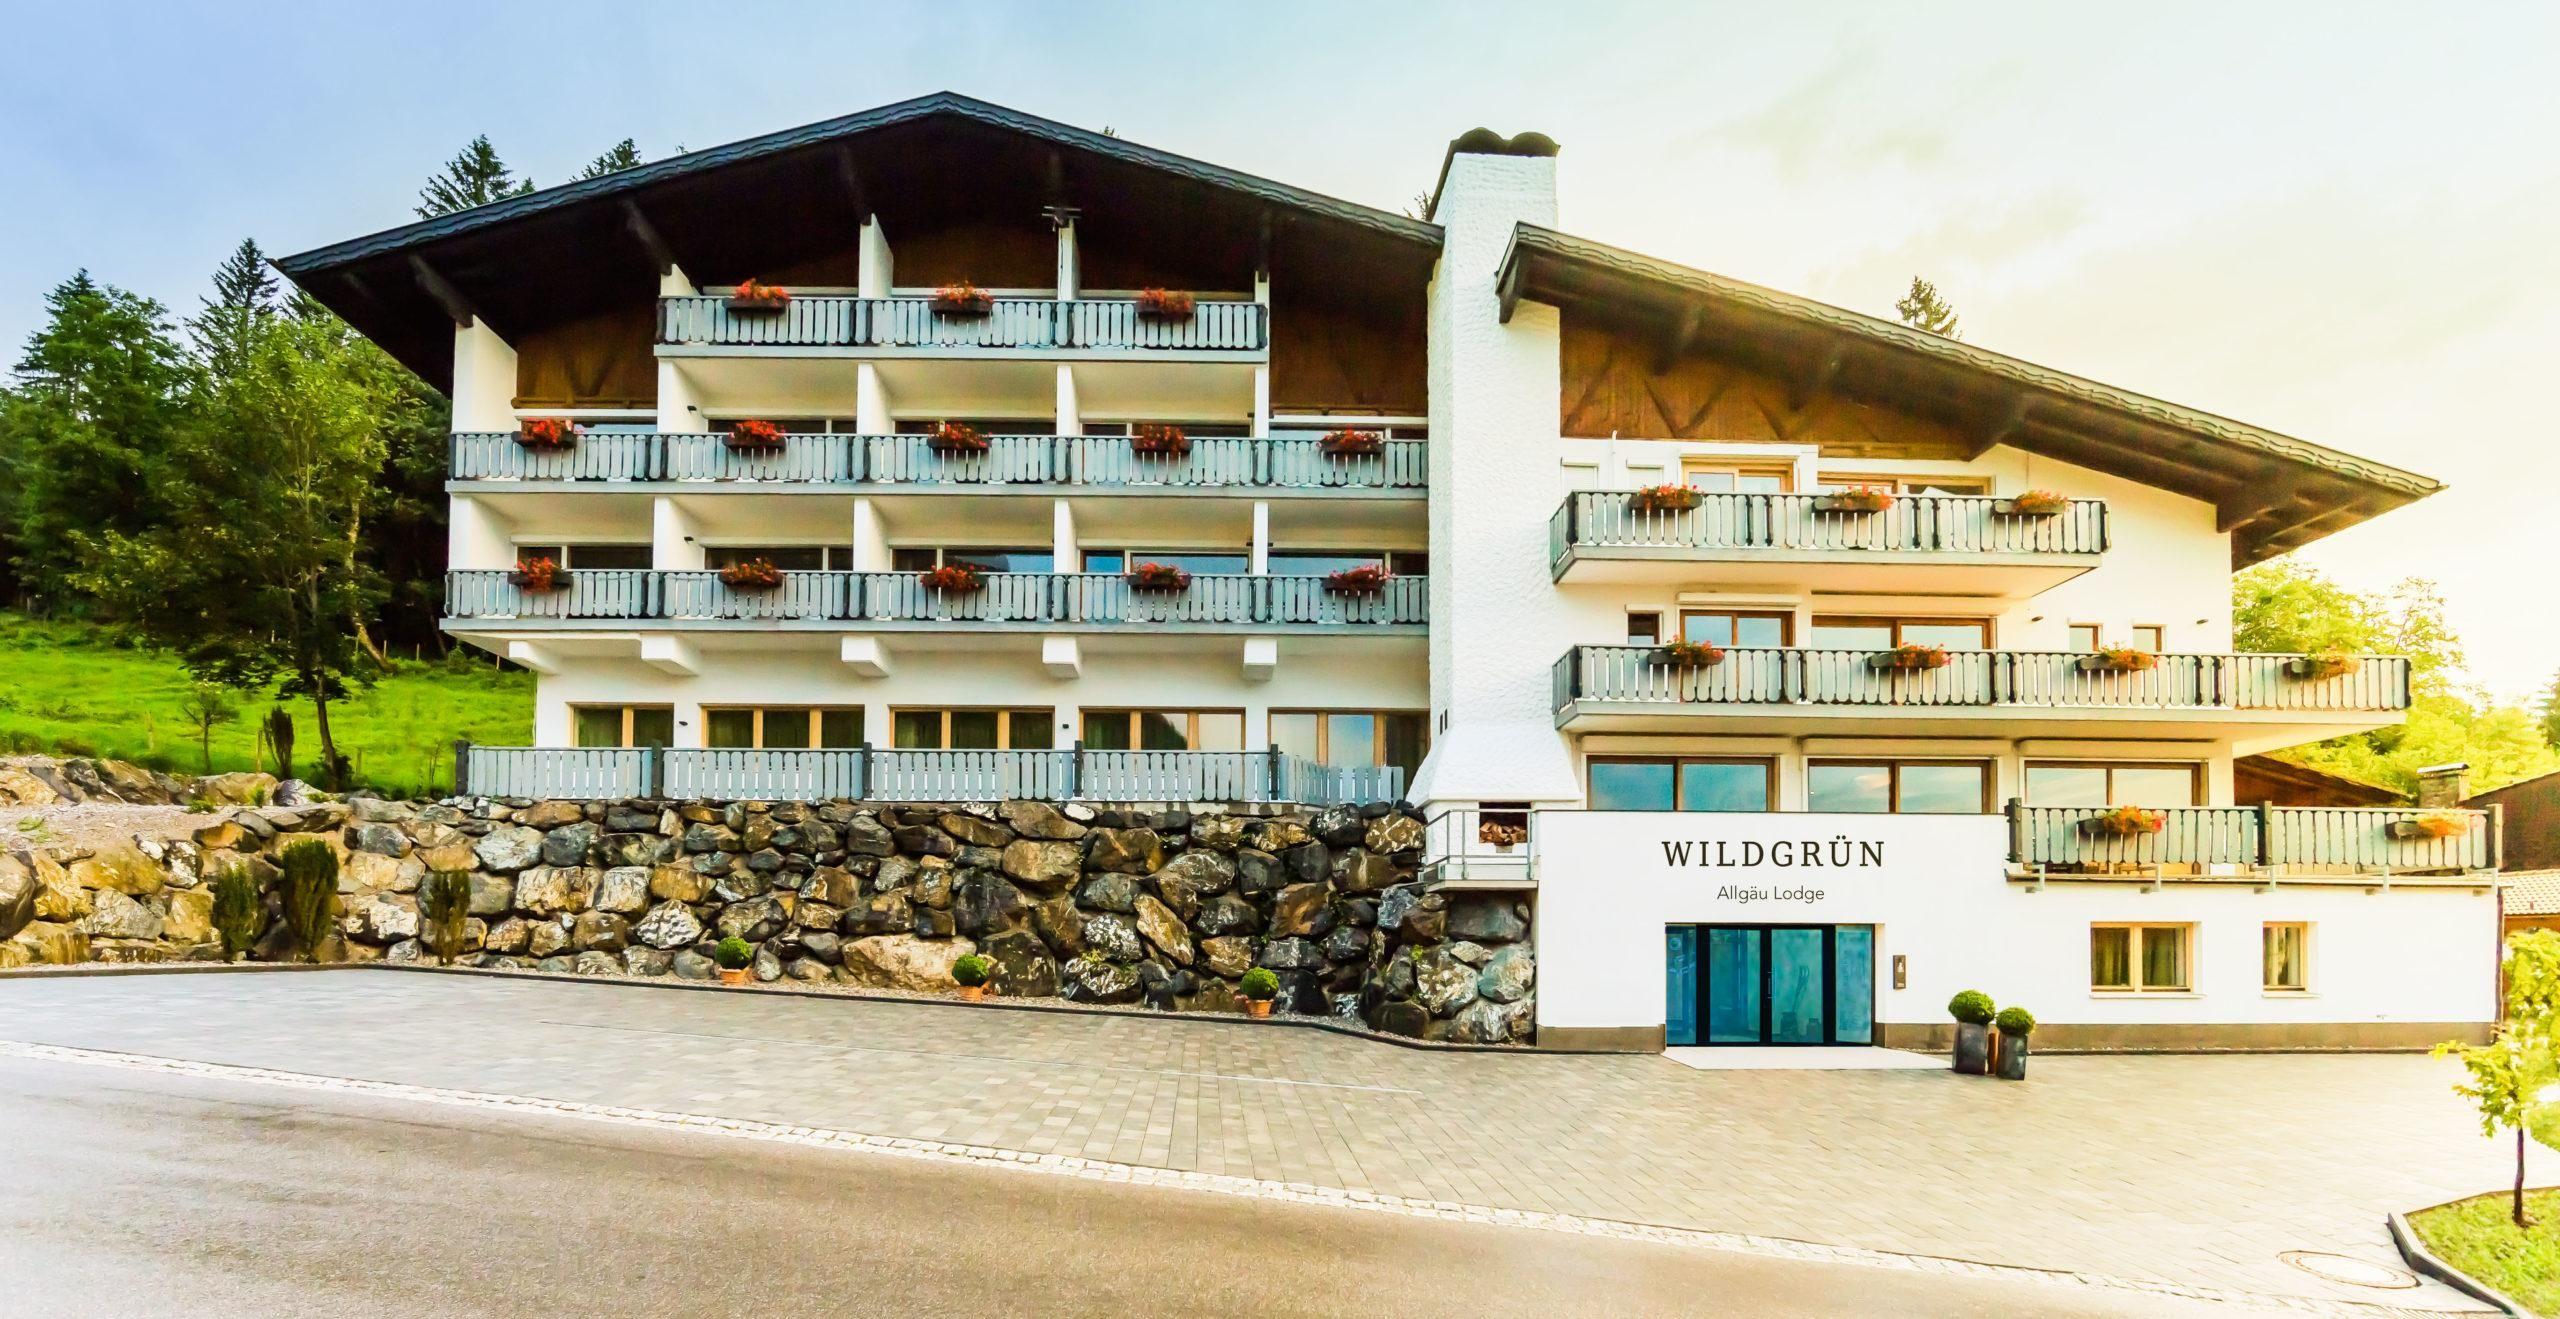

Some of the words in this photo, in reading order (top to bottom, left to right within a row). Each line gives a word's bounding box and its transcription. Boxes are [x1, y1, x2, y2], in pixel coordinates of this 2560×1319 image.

[1661, 835, 1885, 867] WILDGRÜN
[1716, 885, 1768, 904] Allgäu
[1774, 885, 1825, 904] Lodge
